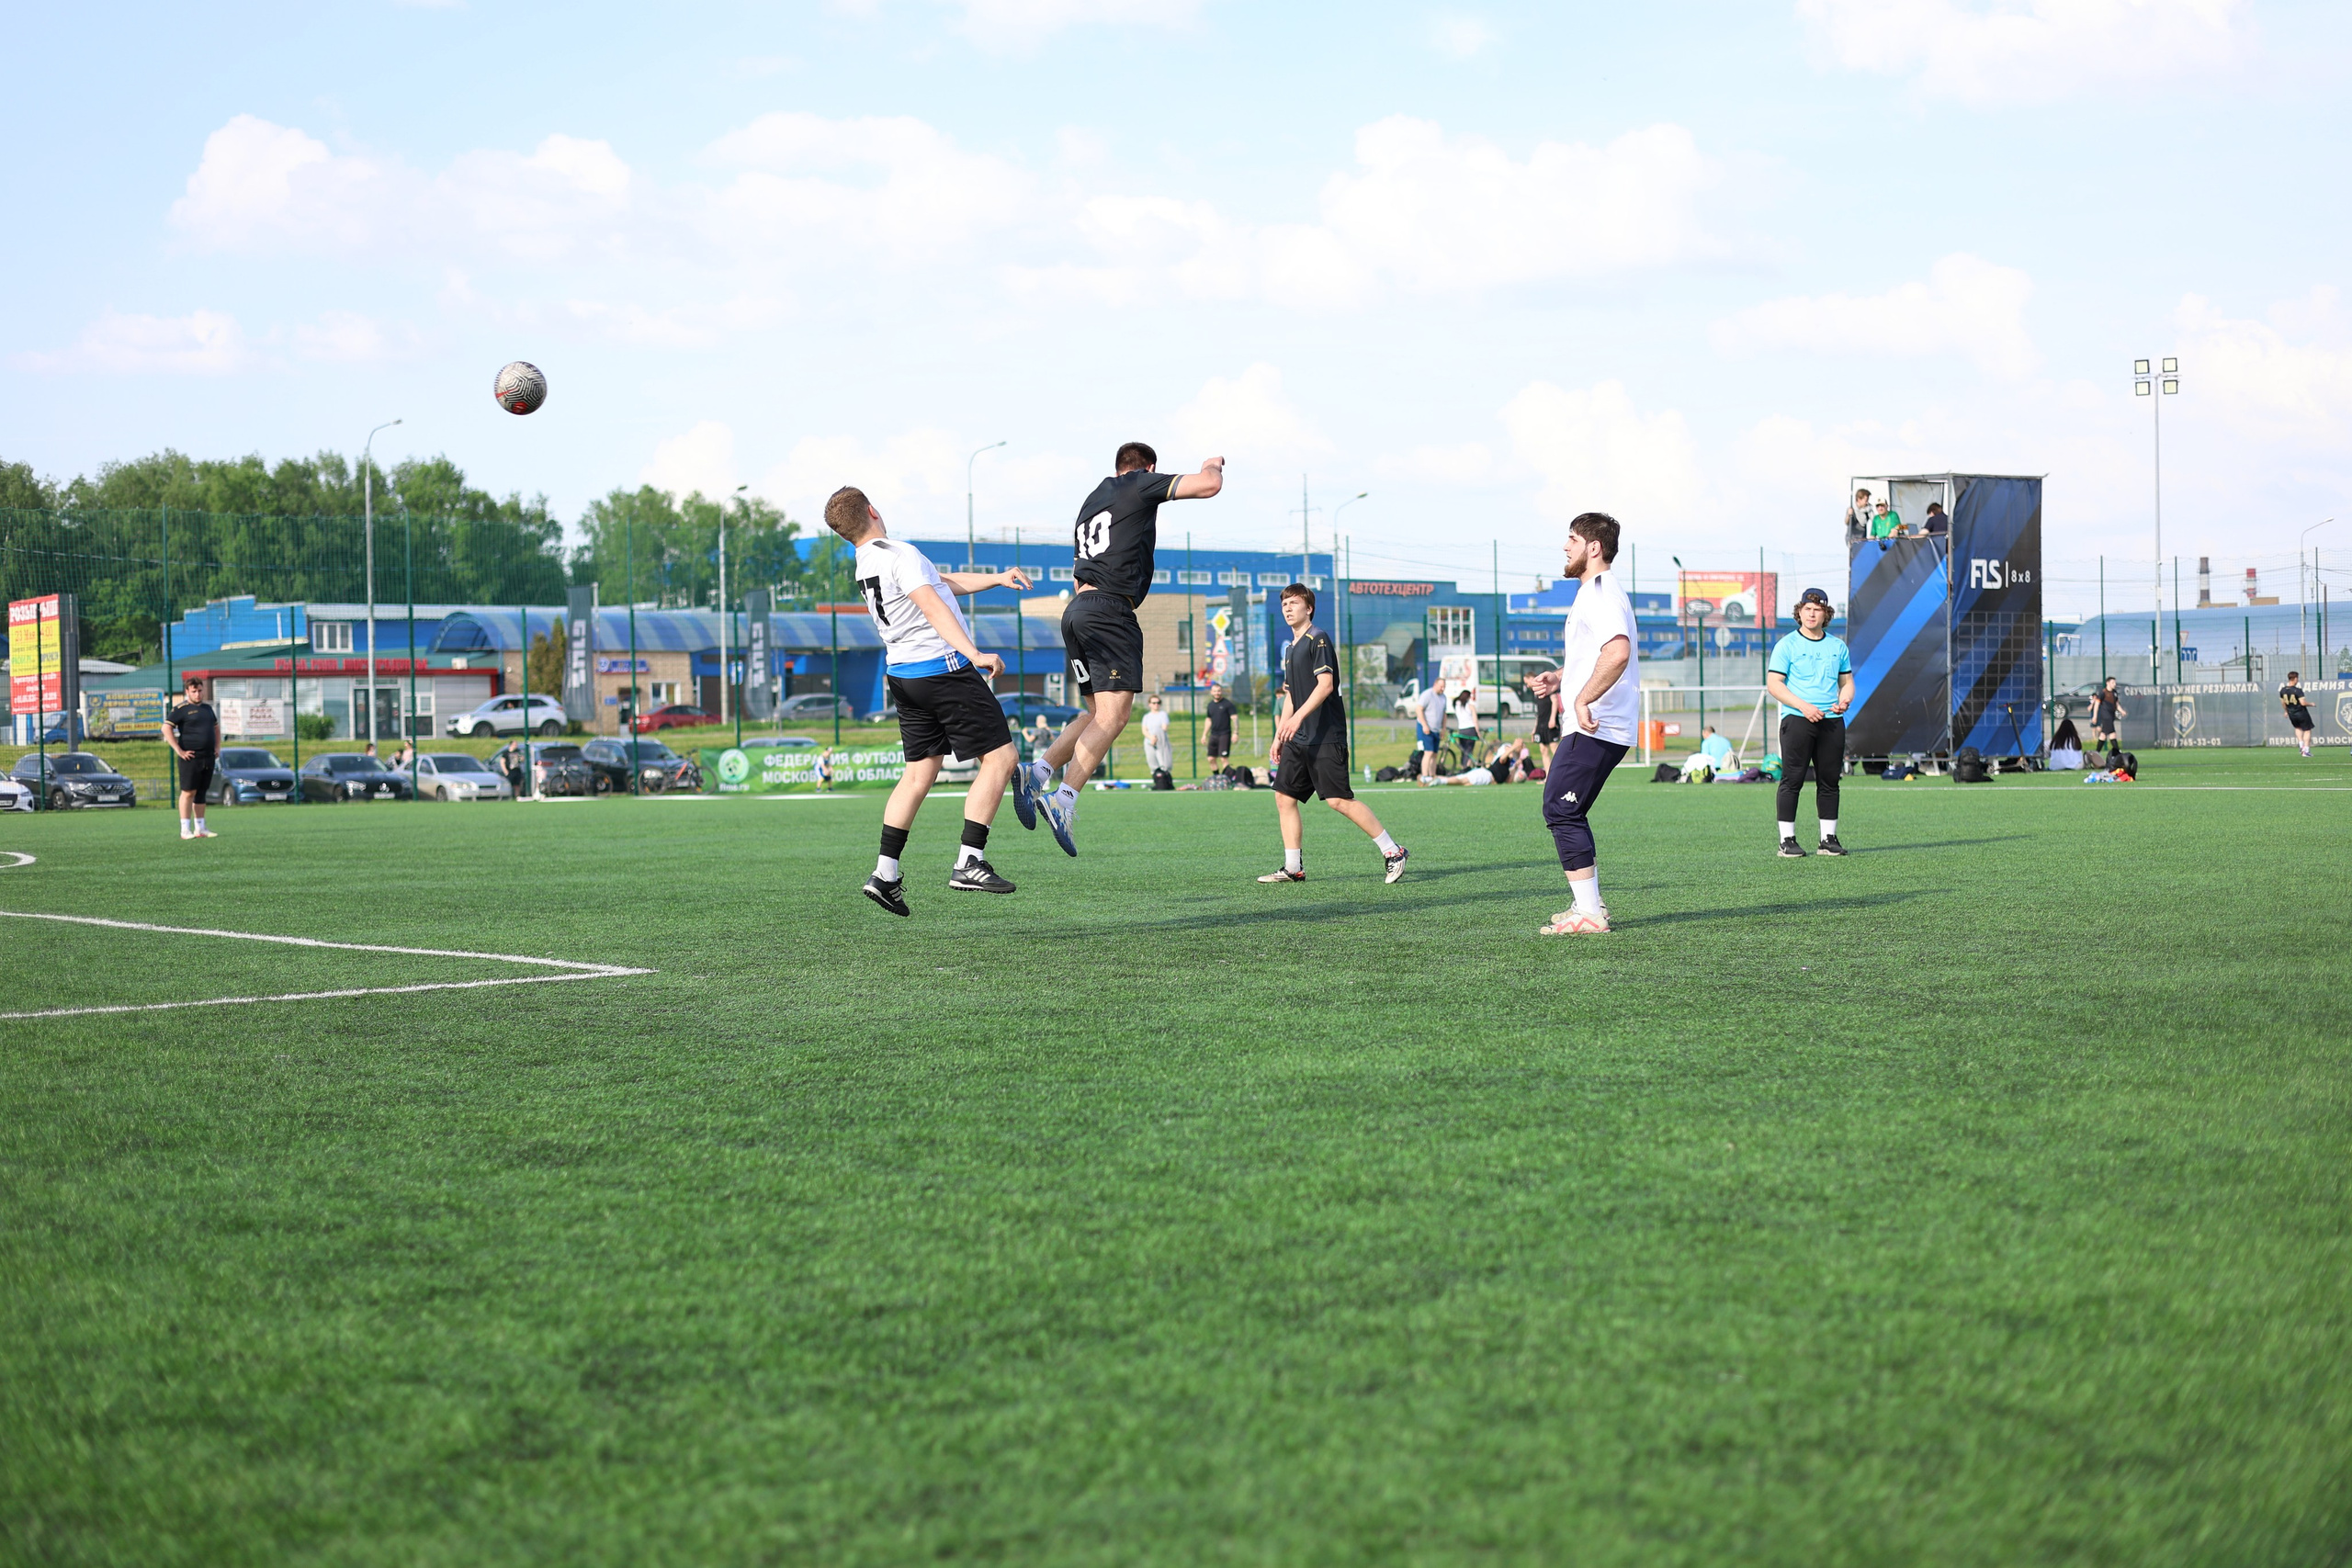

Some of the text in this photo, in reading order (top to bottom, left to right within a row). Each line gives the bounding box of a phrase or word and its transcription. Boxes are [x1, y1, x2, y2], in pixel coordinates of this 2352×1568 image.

[1077, 511, 1112, 560] 10
[1971, 558, 2030, 589] FLS 8x8
[1349, 581, 1434, 597] АВТОТЕХЦЕНТР
[2202, 682, 2259, 694] РЕЗУЛЬТАТА
[2282, 693, 2298, 705] 44
